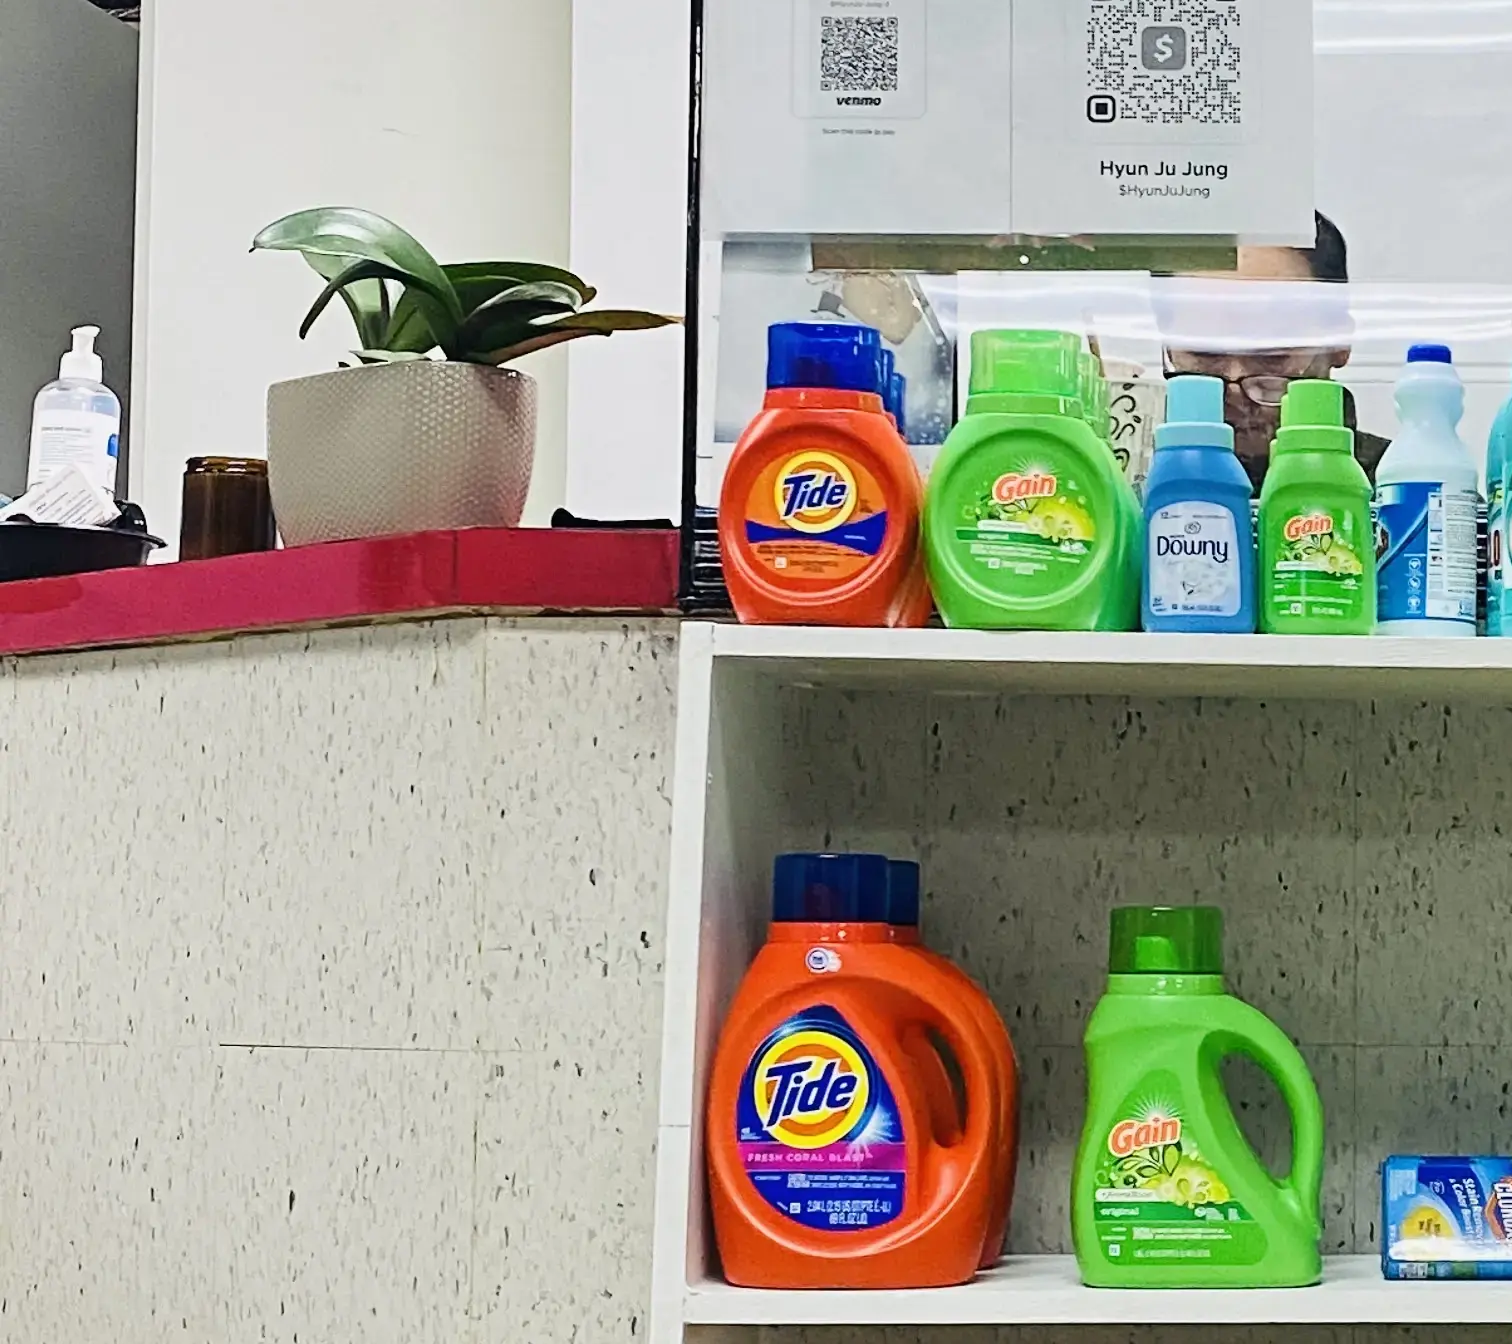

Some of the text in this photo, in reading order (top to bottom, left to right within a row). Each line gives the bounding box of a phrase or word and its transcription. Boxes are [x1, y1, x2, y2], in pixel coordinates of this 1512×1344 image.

[836, 96, 882, 107] venmo
[1100, 160, 1228, 180] Hyun Ju Jung
[1118, 184, 1211, 199] $HyunJuJung
[783, 474, 848, 517] Tide
[995, 473, 1056, 503] Gain
[1286, 514, 1333, 539] Gain
[1156, 535, 1229, 564] Downy
[765, 1060, 858, 1128] Tide
[1111, 1117, 1179, 1155] Gain
[747, 1153, 784, 1163] FRESH
[785, 1153, 825, 1163] CORAL
